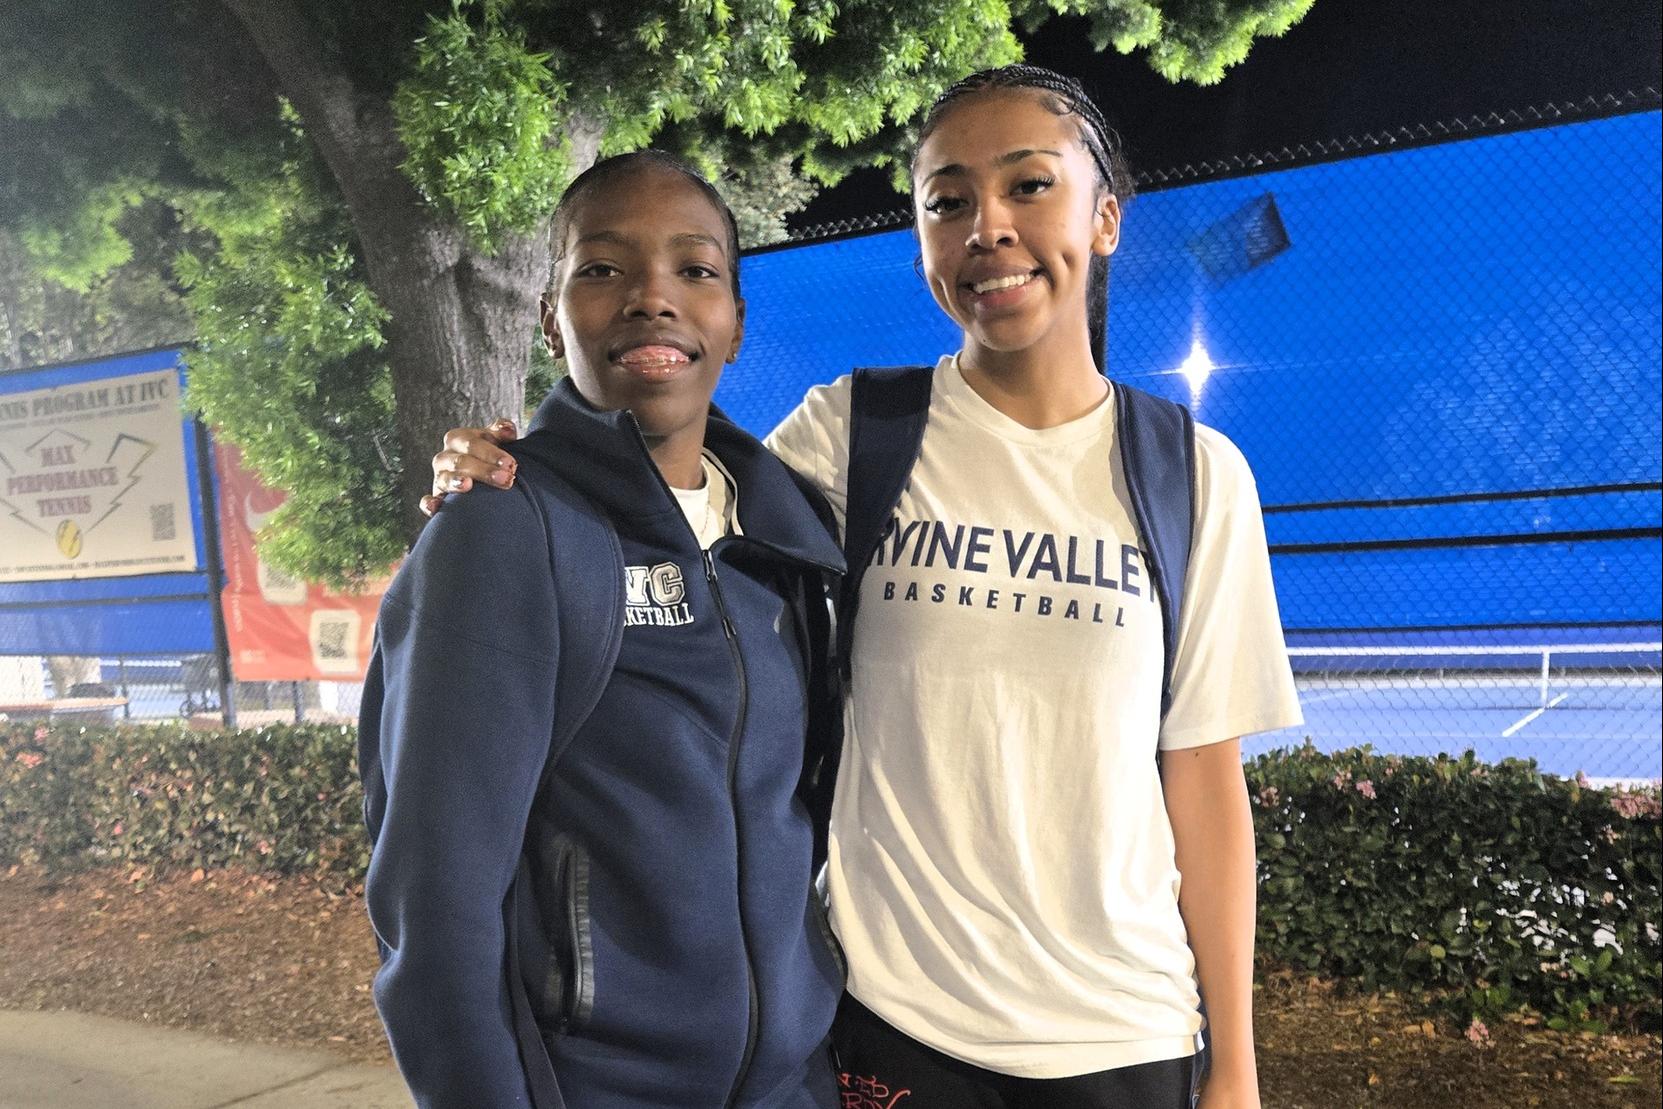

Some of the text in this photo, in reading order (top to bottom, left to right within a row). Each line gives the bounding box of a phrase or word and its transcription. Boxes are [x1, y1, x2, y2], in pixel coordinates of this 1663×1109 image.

[32, 387, 109, 416] PROGRAM
[114, 383, 135, 407] AT
[141, 378, 169, 401] IVC
[40, 445, 76, 467] MAX
[7, 467, 119, 496] PERFORMANCE
[37, 495, 91, 517] TENNIS
[624, 562, 685, 606] VC
[624, 603, 694, 627] KETBALL
[884, 582, 1125, 628] BASKETBALL
